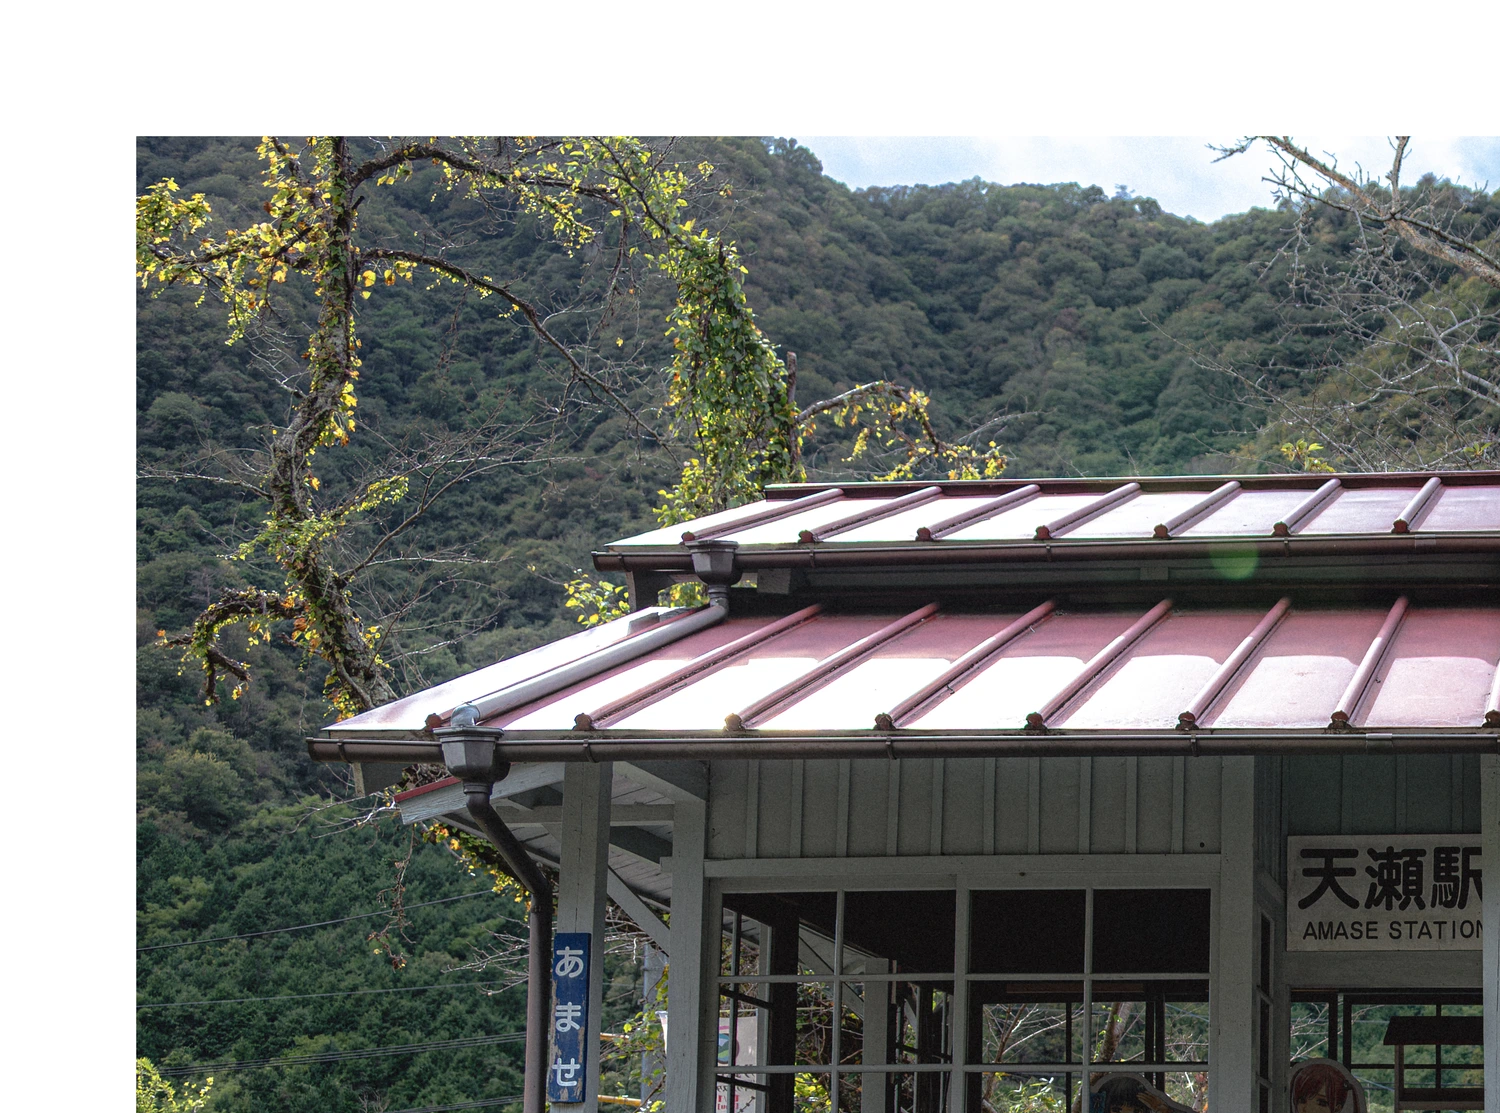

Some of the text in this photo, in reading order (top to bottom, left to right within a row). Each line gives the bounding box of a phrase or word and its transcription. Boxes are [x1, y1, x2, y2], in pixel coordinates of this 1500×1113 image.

[1298, 846, 1482, 910] 天瀬駅
[1303, 920, 1379, 940] AMASE
[552, 946, 585, 1087] あませ
